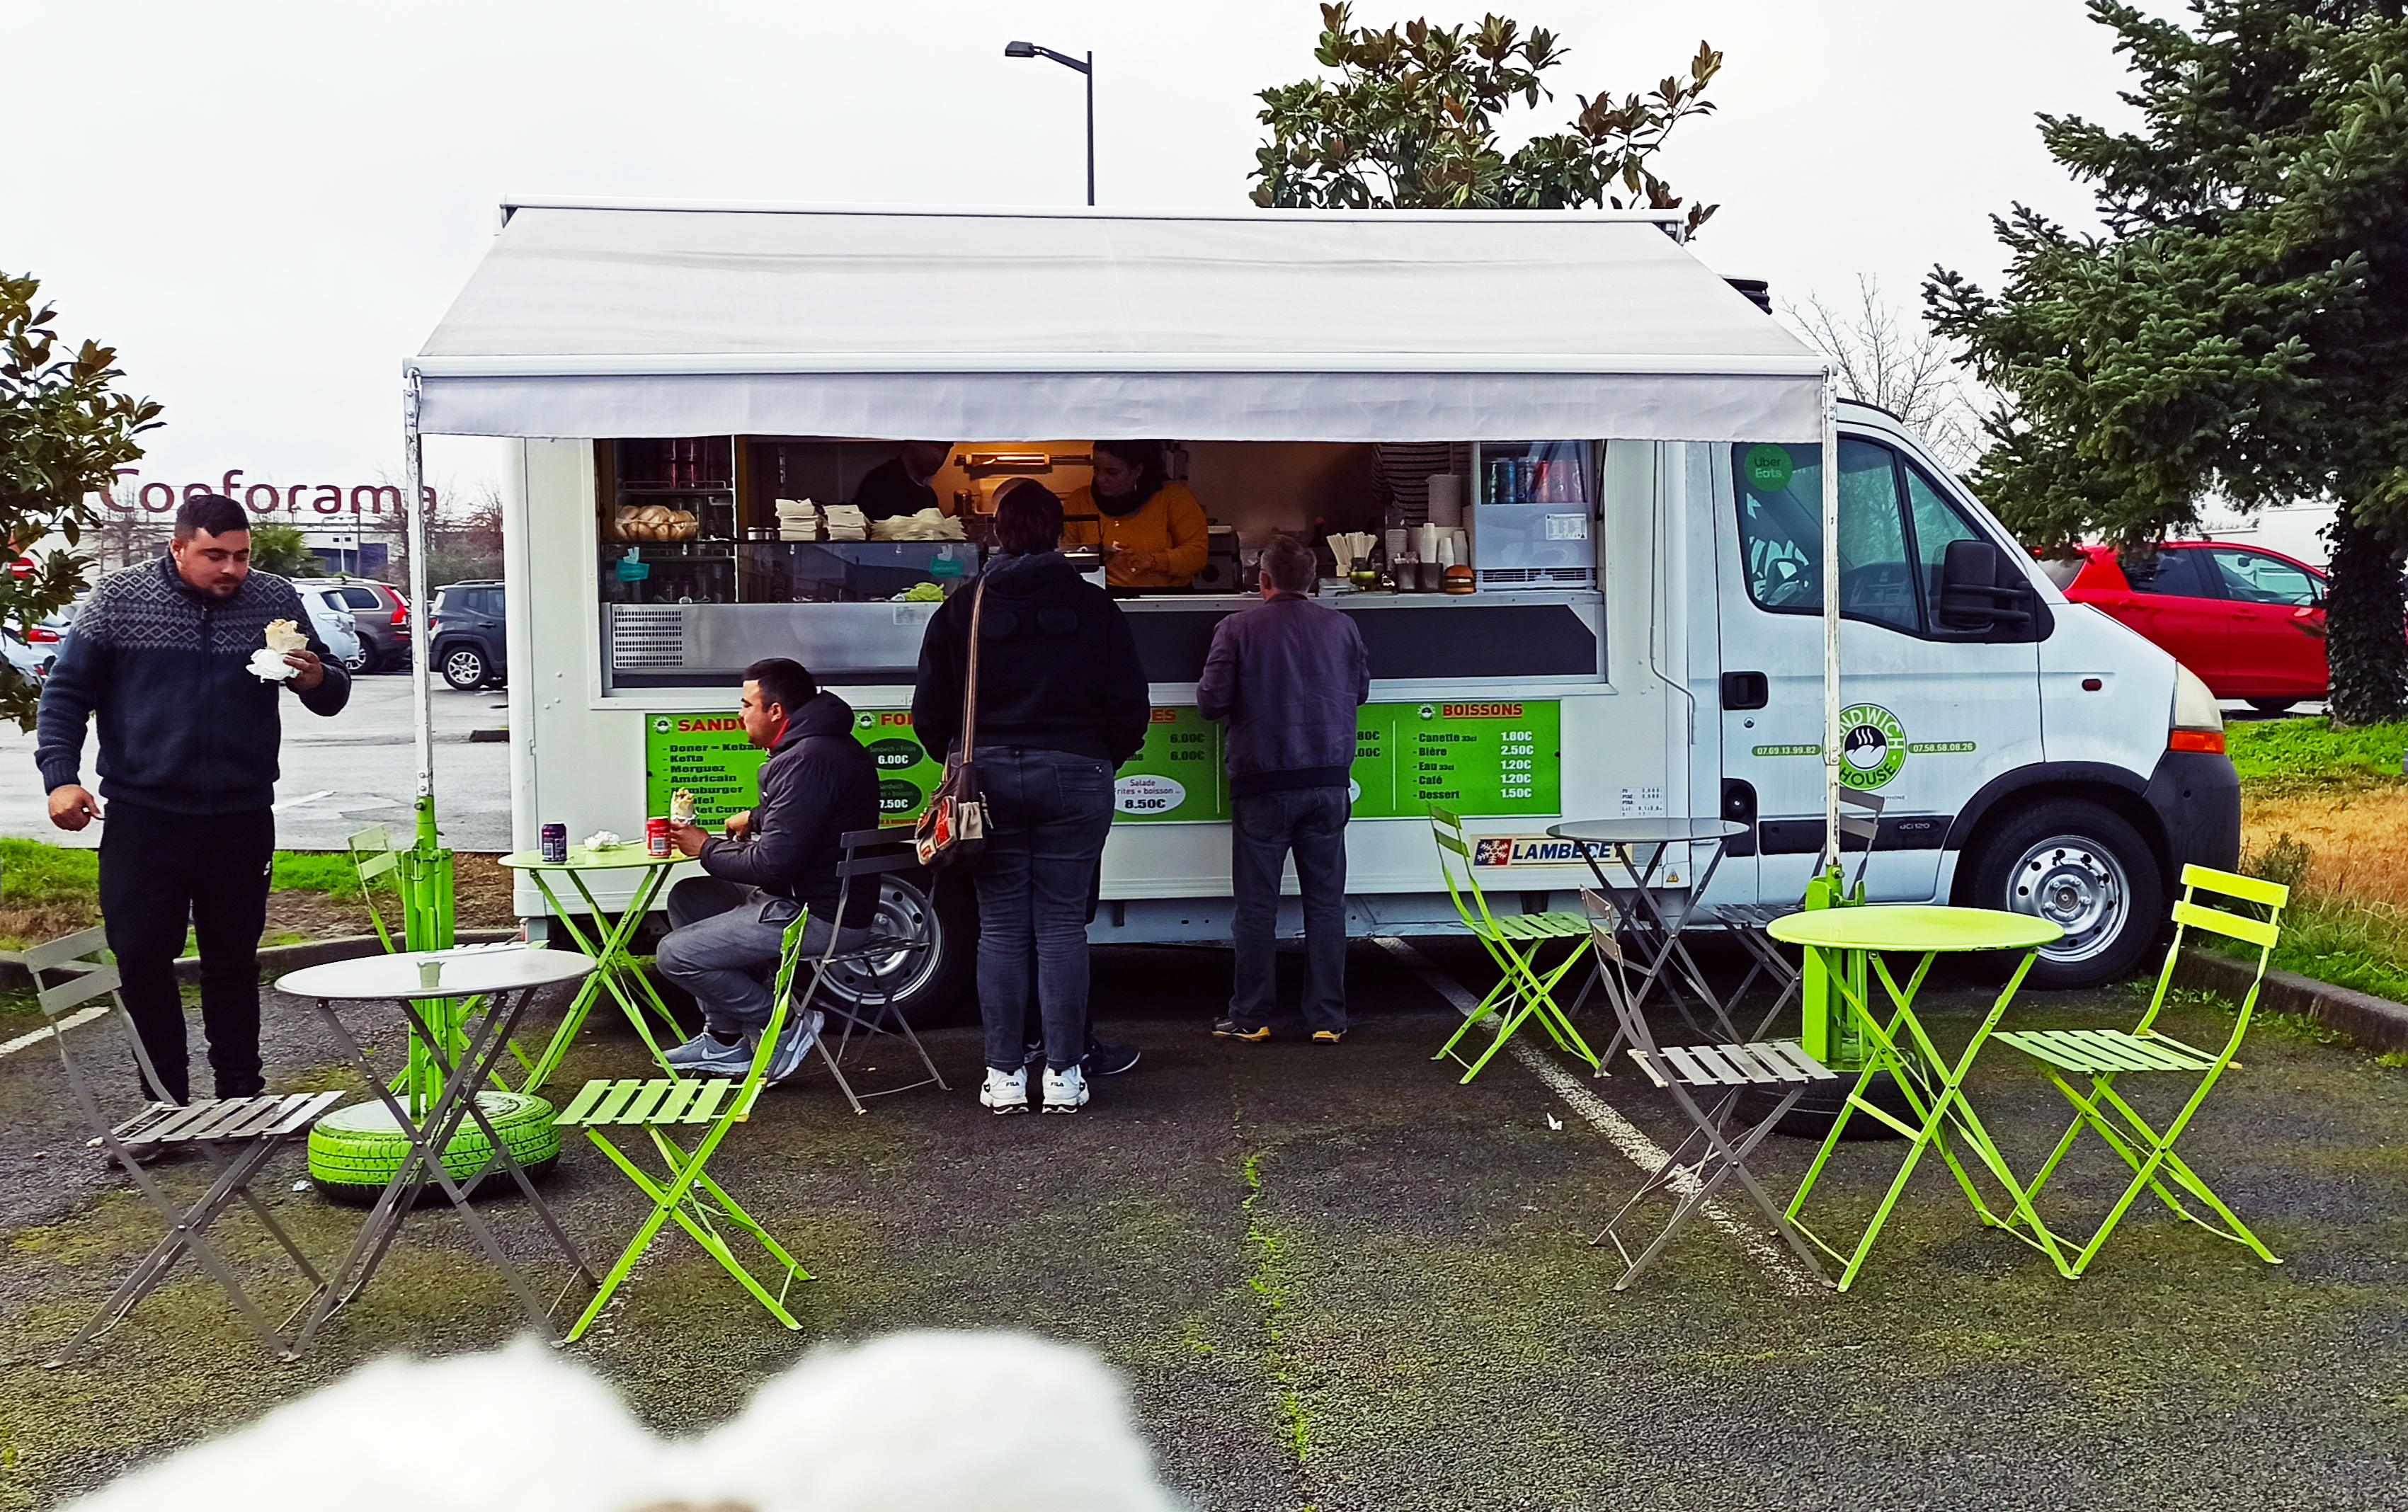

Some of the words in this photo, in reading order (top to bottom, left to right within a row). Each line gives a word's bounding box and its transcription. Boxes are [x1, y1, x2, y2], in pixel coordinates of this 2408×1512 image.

[1754, 457, 1781, 467] Uber
[1755, 468, 1782, 478] Eats
[1151, 709, 1177, 721] ES
[1443, 704, 1523, 716] BOISSONS
[1170, 733, 1205, 743] 6.00€
[1419, 733, 1460, 742] Canette
[1500, 731, 1532, 741] 1.80€
[1354, 748, 1381, 757] .00€
[1419, 747, 1447, 756] Bière
[1500, 745, 1534, 755] 2.50€
[878, 755, 909, 764] 6.00€
[1170, 751, 1205, 761] 6.00€
[1419, 761, 1437, 771] Eau
[1500, 760, 1531, 769] 1.20€
[671, 774, 737, 783] Américain
[1419, 775, 1443, 784] Café
[1500, 774, 1531, 784] 1.20€
[1839, 763, 1897, 786] HOUSE
[1419, 790, 1460, 799] Dessert
[1500, 788, 1532, 798] 1.50€
[1124, 799, 1166, 809] 8.50€
